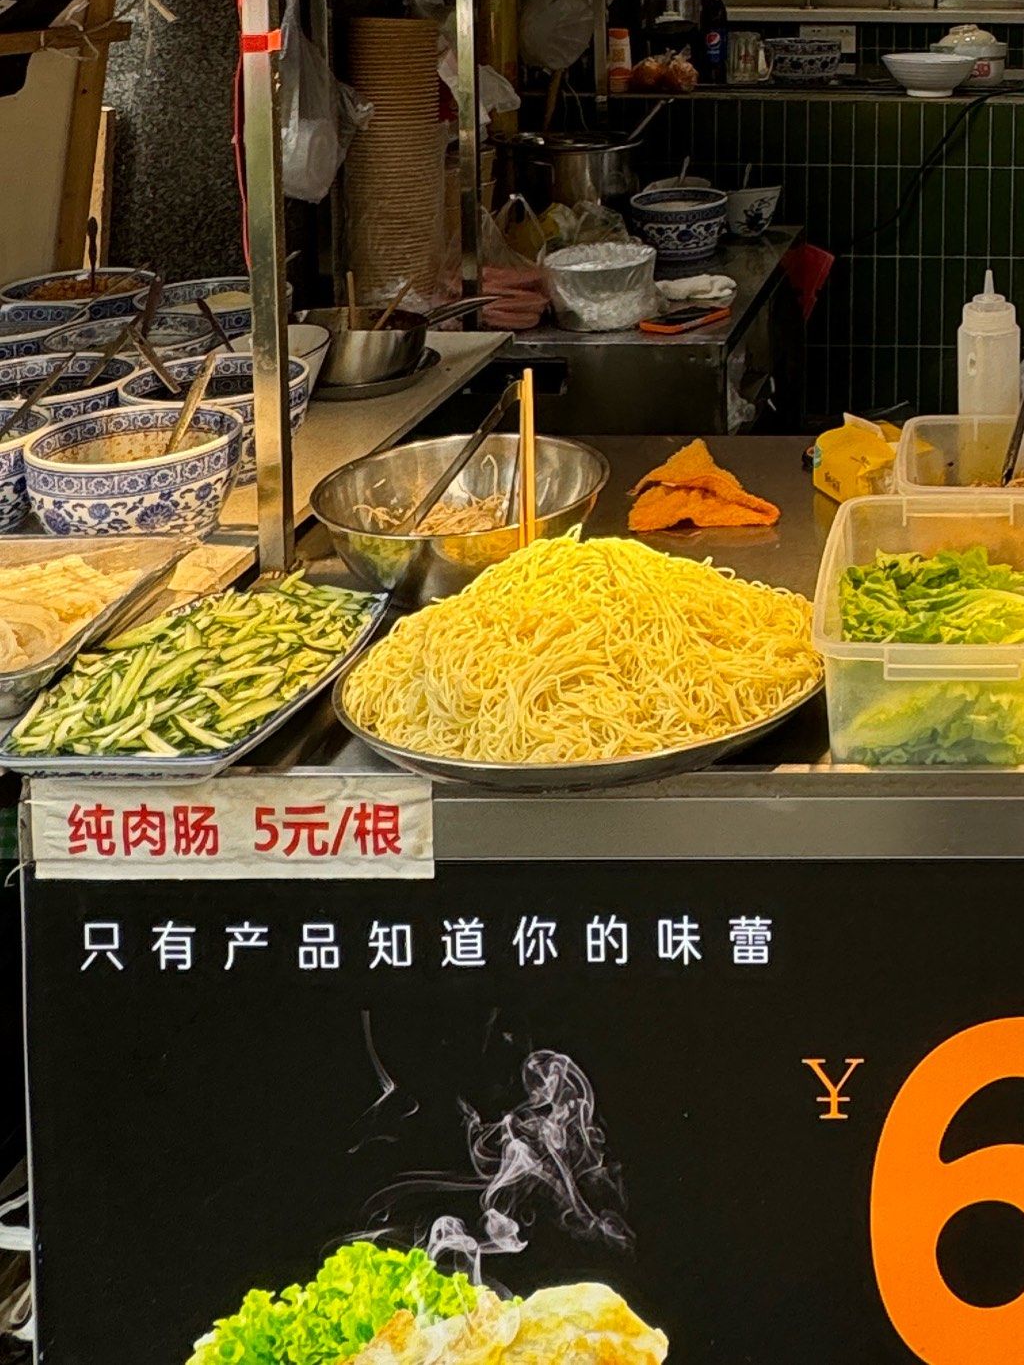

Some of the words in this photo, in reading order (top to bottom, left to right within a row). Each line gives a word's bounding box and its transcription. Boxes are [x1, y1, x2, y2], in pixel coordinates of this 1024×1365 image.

[67, 803, 220, 857] 纯肉肠
[254, 803, 402, 858] 5元/根
[80, 914, 775, 972] 只有产品知道你的味蕾
